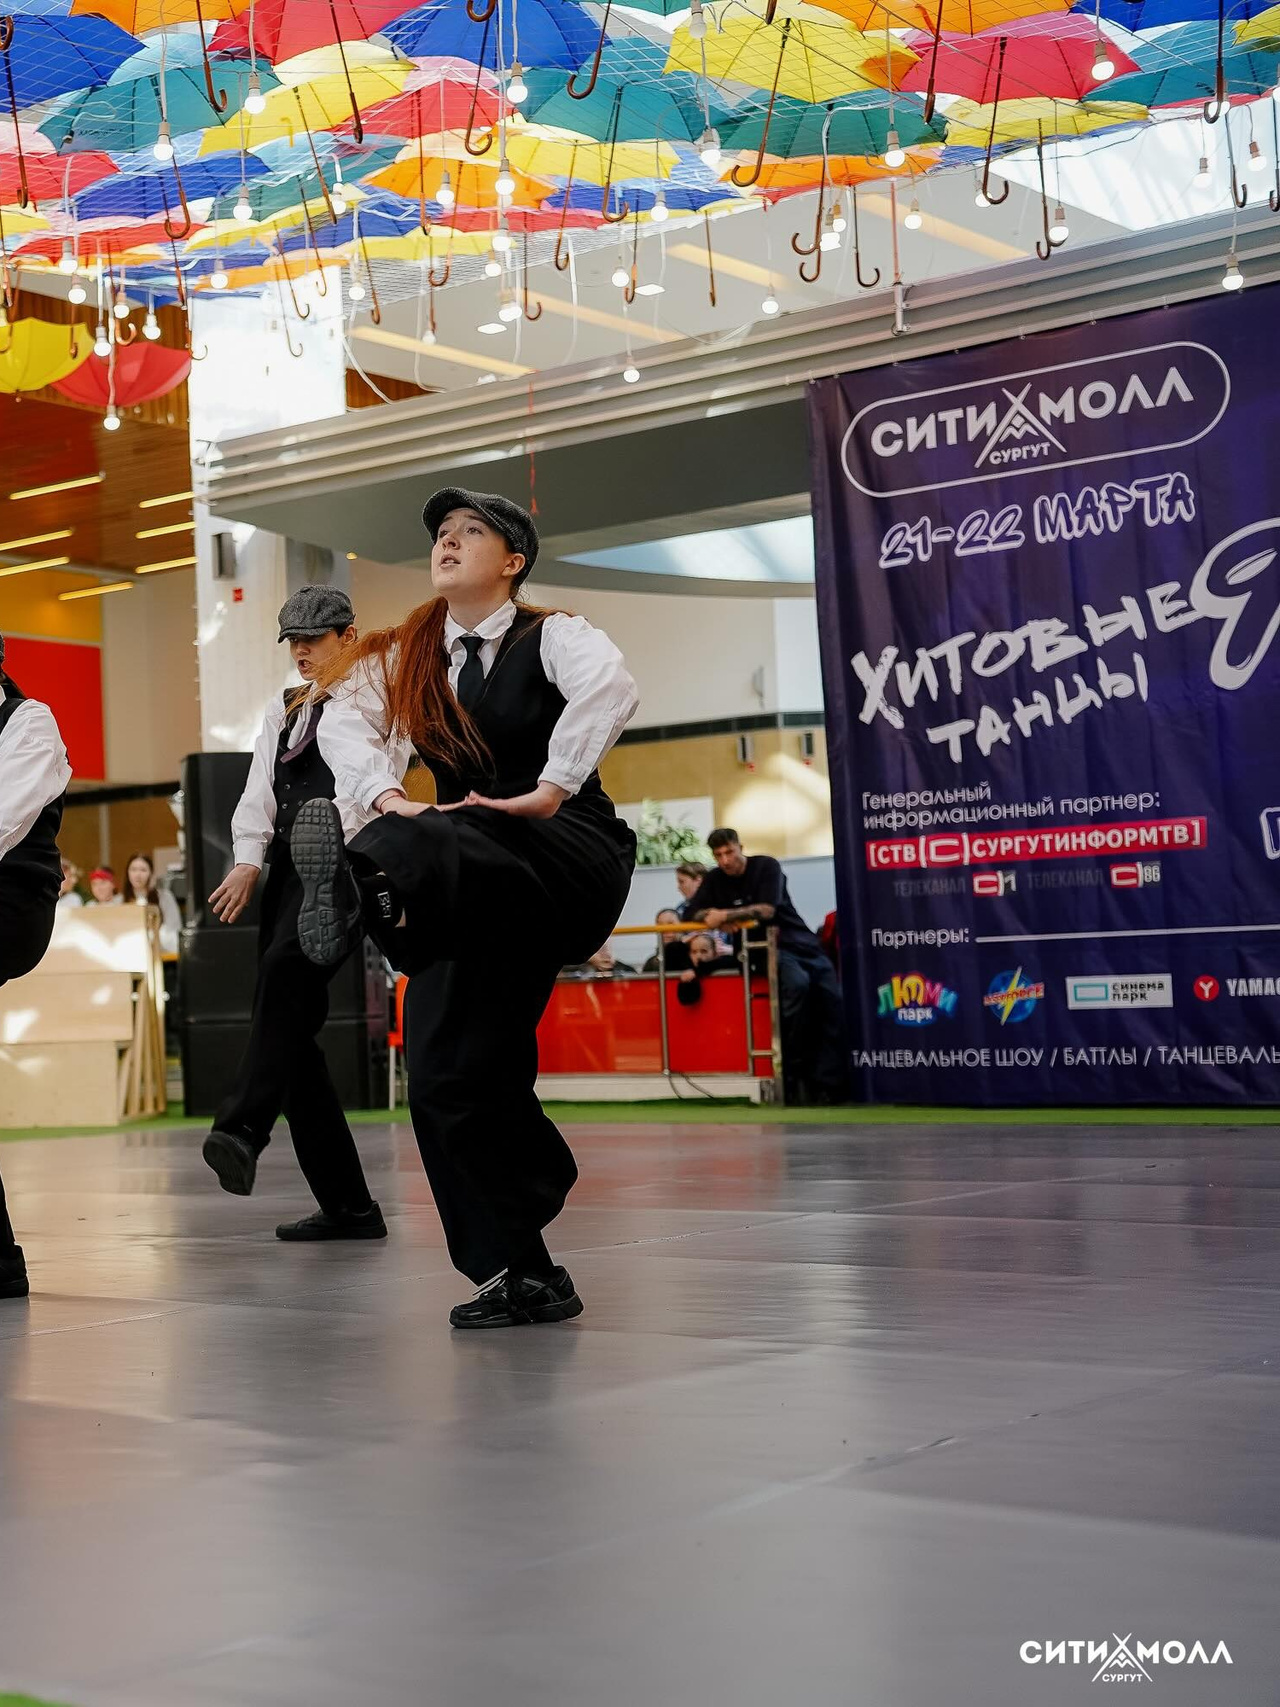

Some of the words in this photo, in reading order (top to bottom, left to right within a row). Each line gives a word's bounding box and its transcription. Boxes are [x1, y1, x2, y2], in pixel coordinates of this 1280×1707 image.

[990, 442, 1051, 464] СУРГУТ
[879, 505, 1025, 569] 21-22
[1034, 472, 1196, 544] МАРТА
[851, 581, 1202, 729] ХИТОВЫЕ
[927, 652, 1149, 763] ТАНЦЫ
[862, 781, 992, 811] Генеральный
[863, 796, 1055, 831] информационный
[1060, 791, 1161, 816] партнер:
[871, 928, 970, 949] Партнеры:
[898, 1007, 933, 1023] парк
[851, 1048, 991, 1069] ТАНЦЕВАЛЬНОЕ
[995, 1047, 1045, 1067] ШОУ
[1063, 1046, 1137, 1066] БАТТЛЫ
